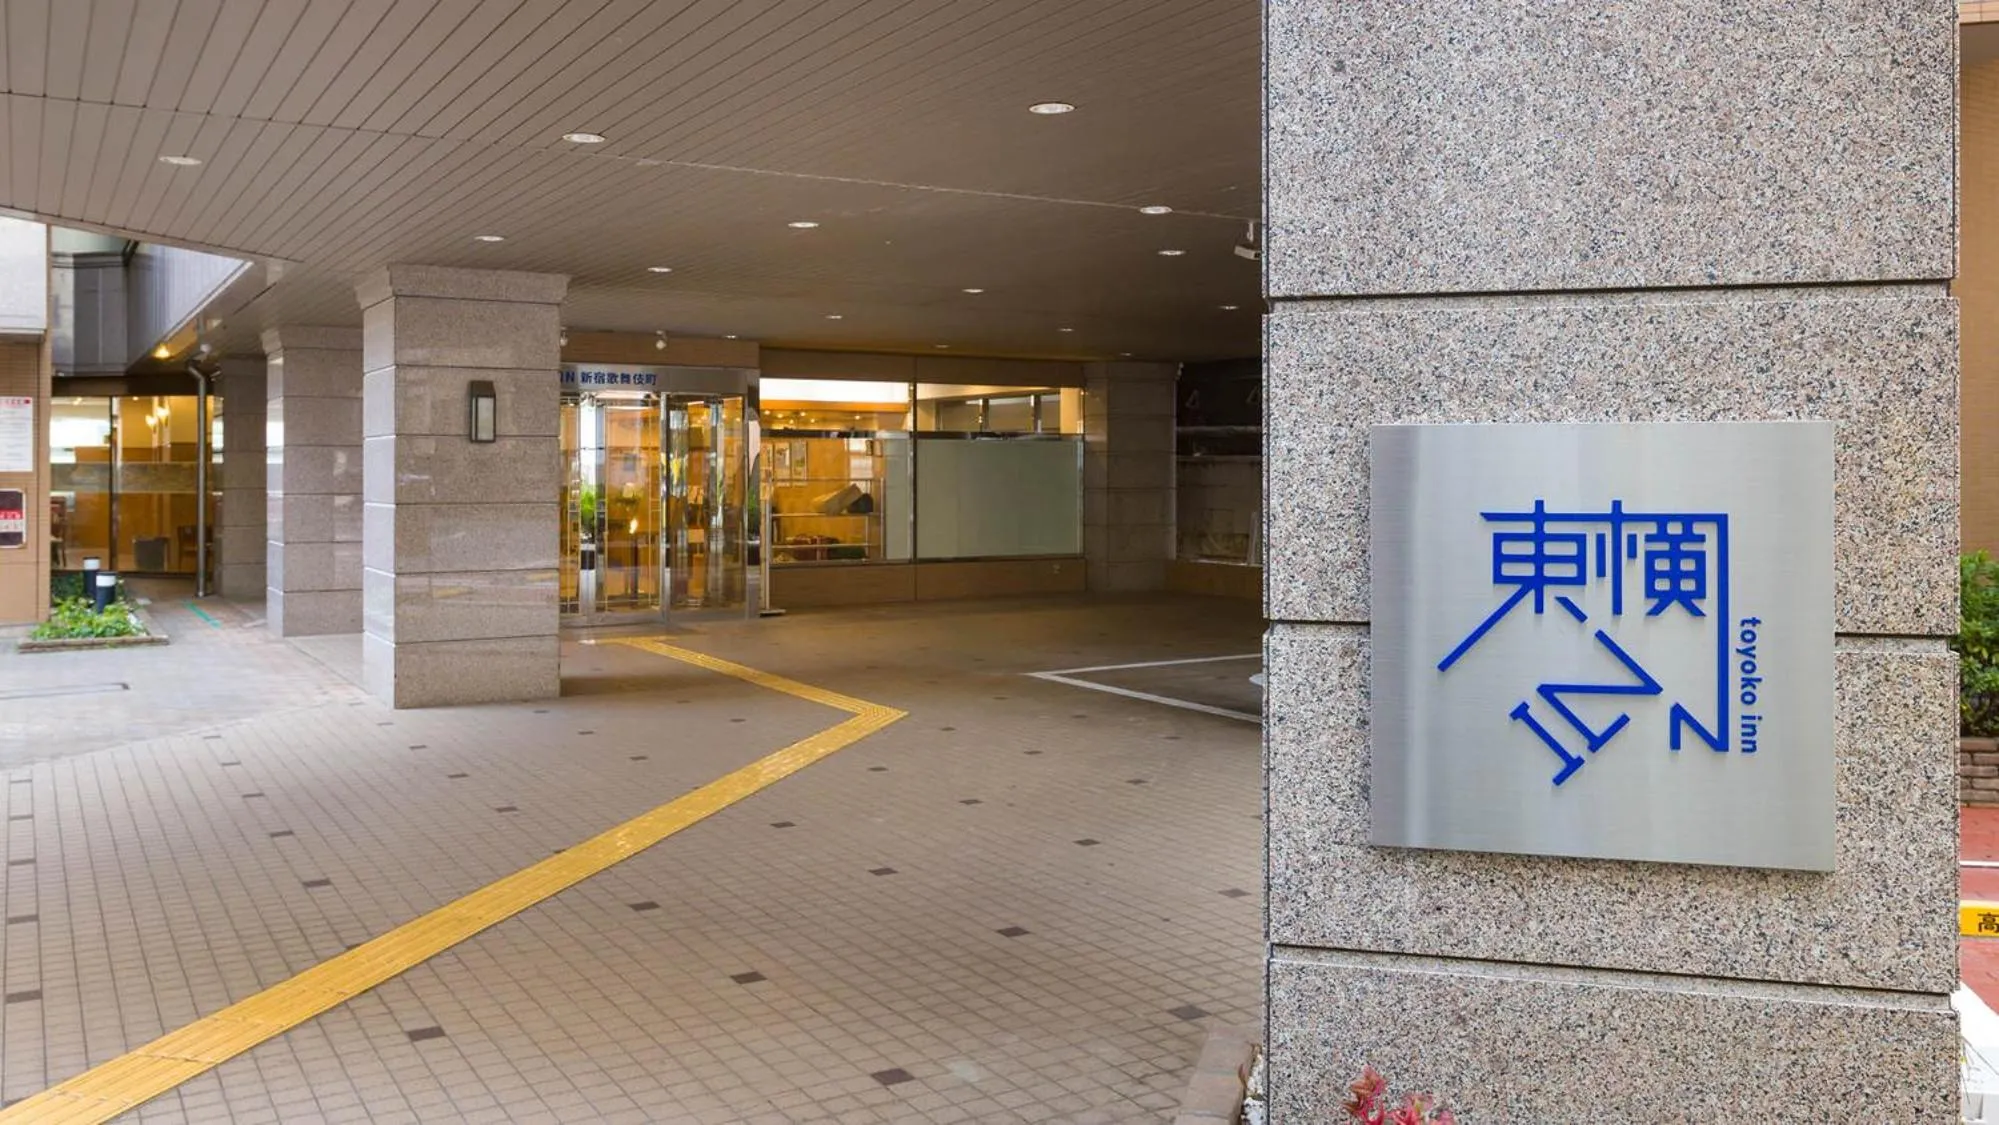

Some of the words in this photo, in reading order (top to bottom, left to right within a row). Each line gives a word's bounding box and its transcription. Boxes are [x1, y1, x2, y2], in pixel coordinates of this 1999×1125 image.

[581, 371, 657, 386] 新宿歌舞伎町
[1736, 617, 1763, 705] toyoko
[1741, 714, 1763, 753] inn
[1977, 911, 1999, 933] 高
